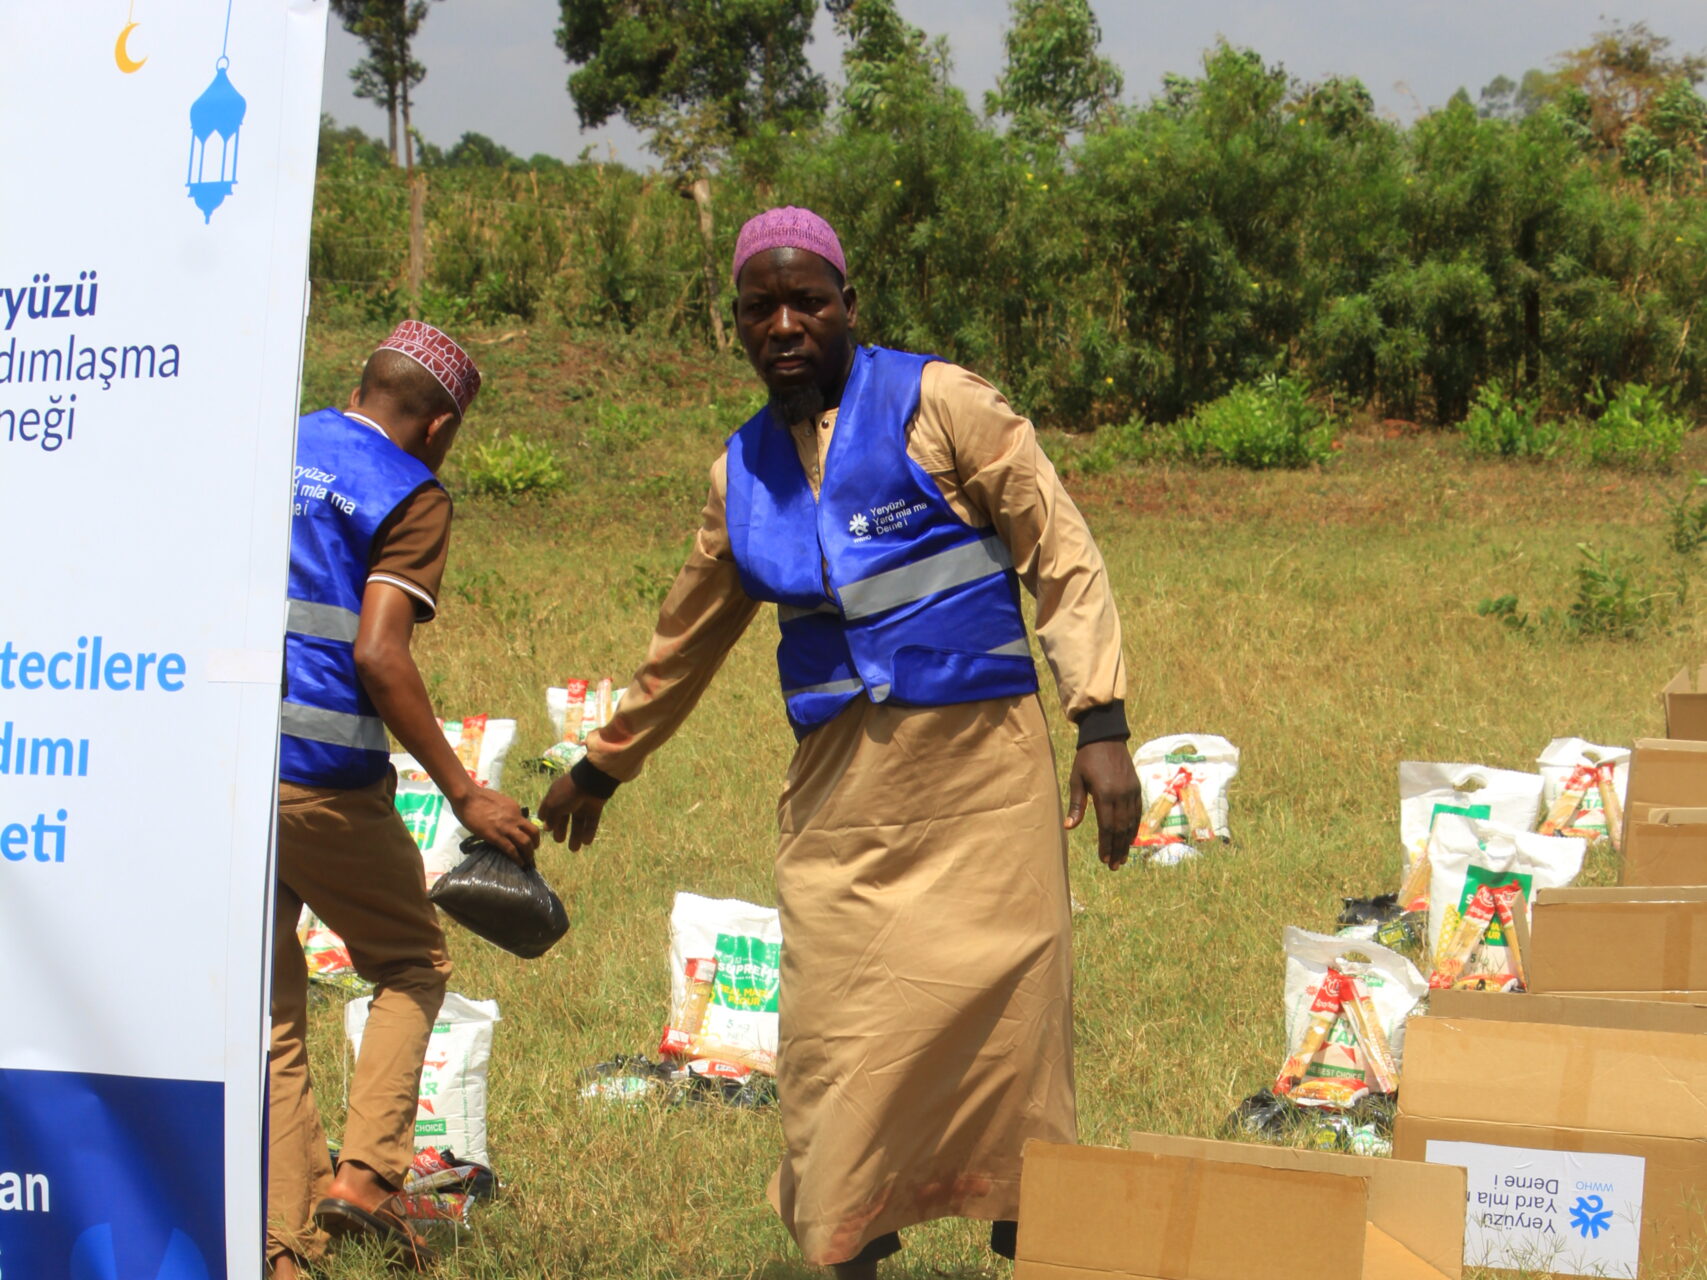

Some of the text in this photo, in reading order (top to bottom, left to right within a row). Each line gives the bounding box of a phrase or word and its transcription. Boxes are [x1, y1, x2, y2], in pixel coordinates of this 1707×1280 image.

[331, 492, 356, 516] ma
[913, 503, 928, 513] ma
[1504, 1175, 1559, 1195] Derne
[1576, 1180, 1614, 1193] WWHO
[1515, 1195, 1558, 1214] Yard
